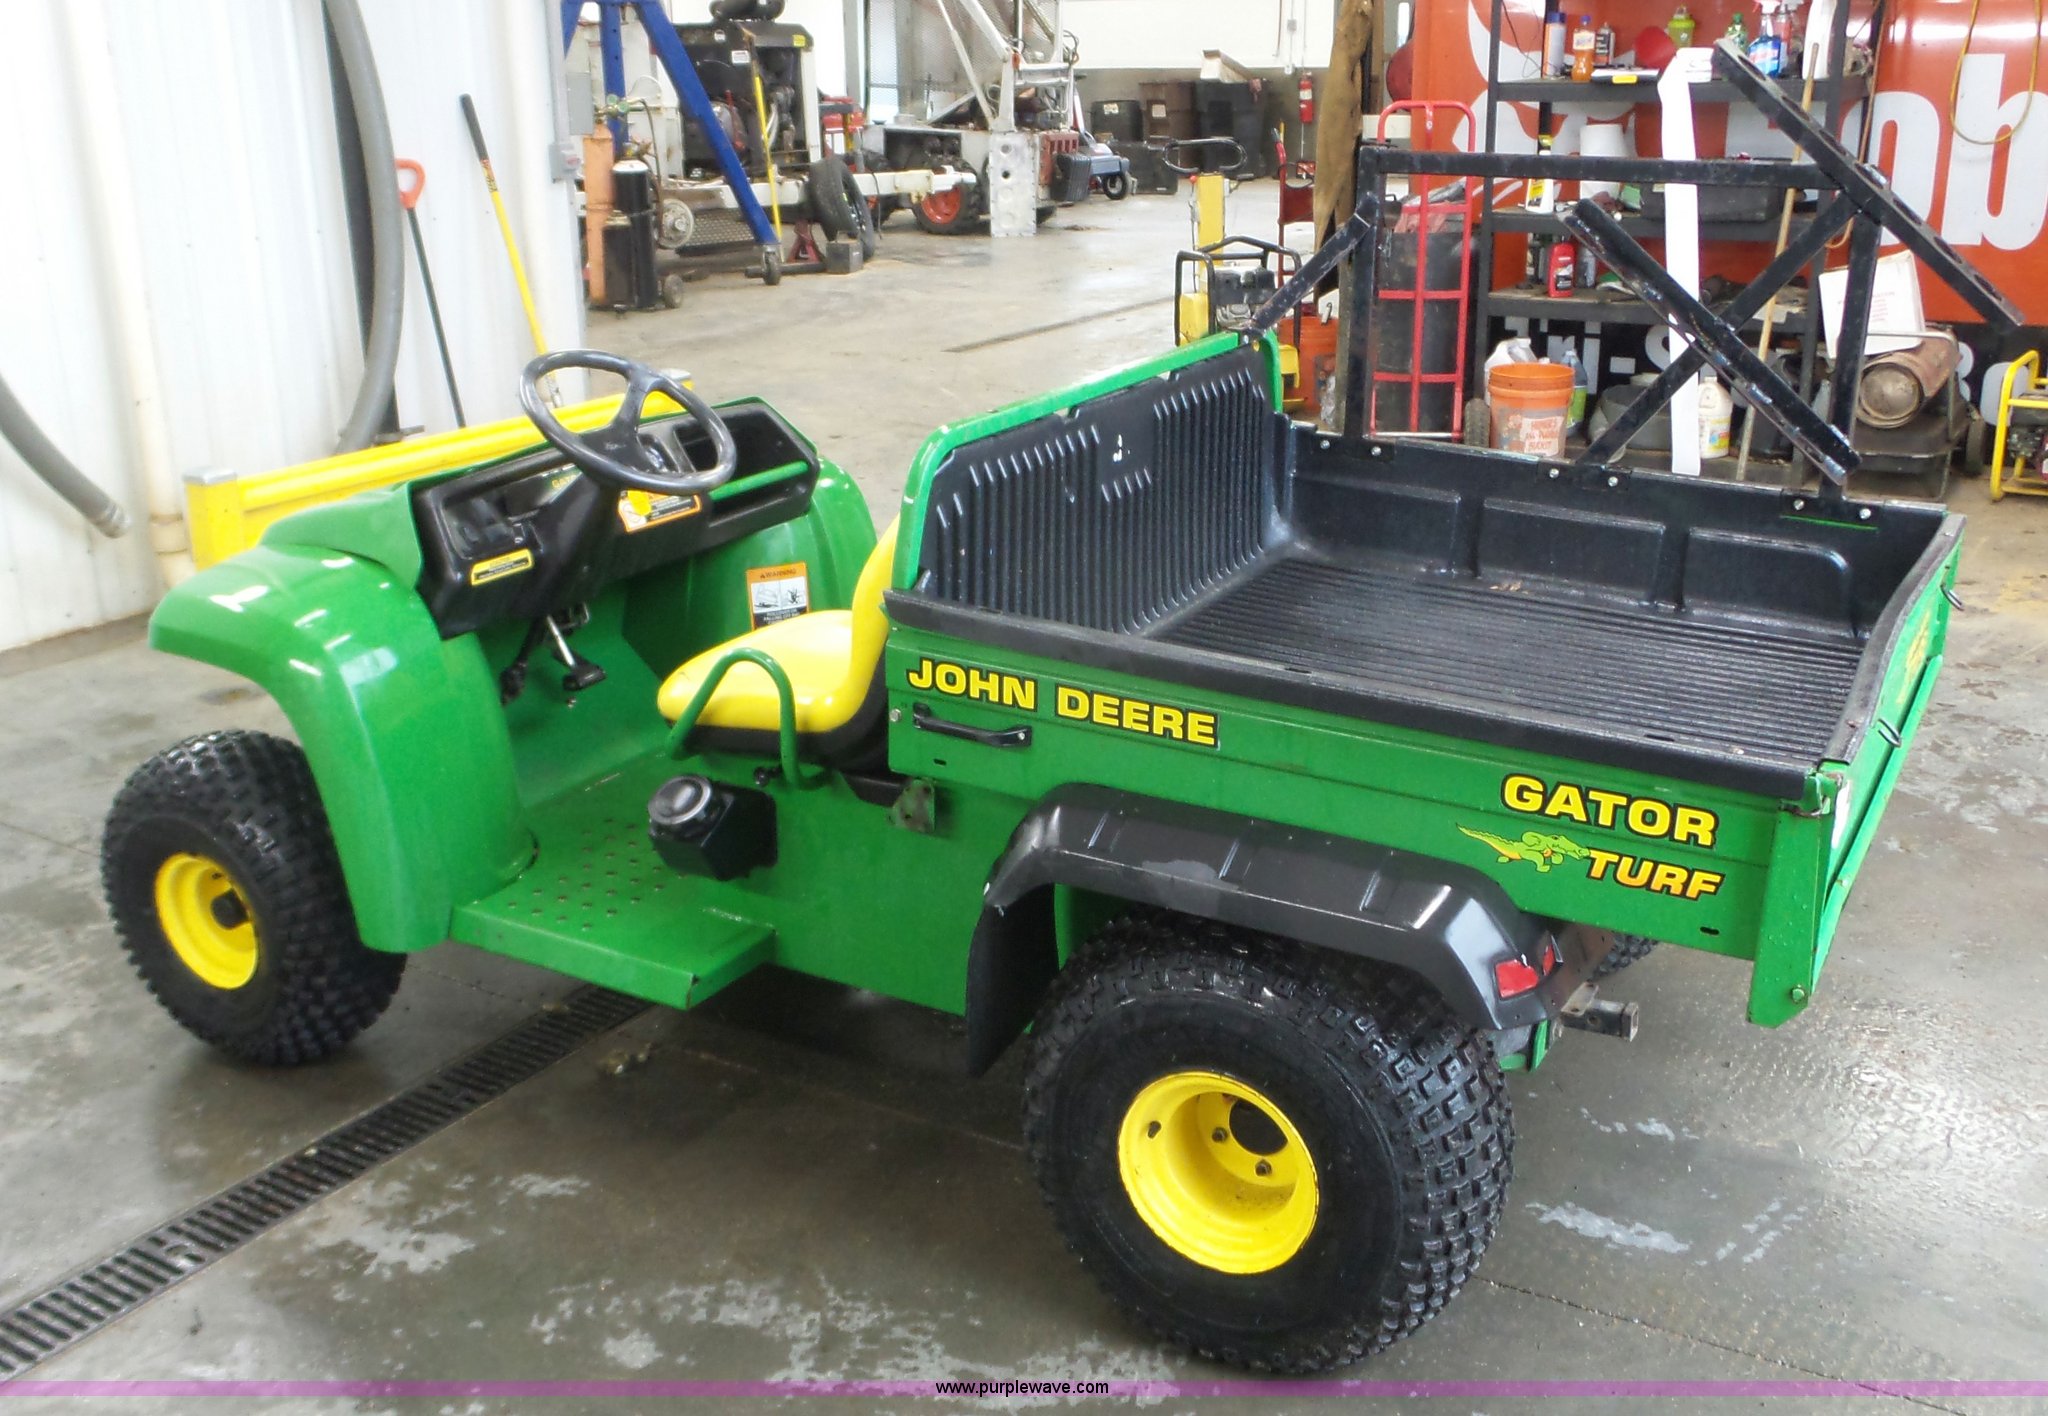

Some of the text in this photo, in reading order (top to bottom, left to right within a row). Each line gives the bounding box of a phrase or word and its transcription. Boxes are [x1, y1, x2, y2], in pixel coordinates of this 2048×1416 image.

[907, 658, 1219, 748] JOHN DEERE
[1502, 773, 1719, 848] GATOR
[1586, 848, 1725, 901] TURF
